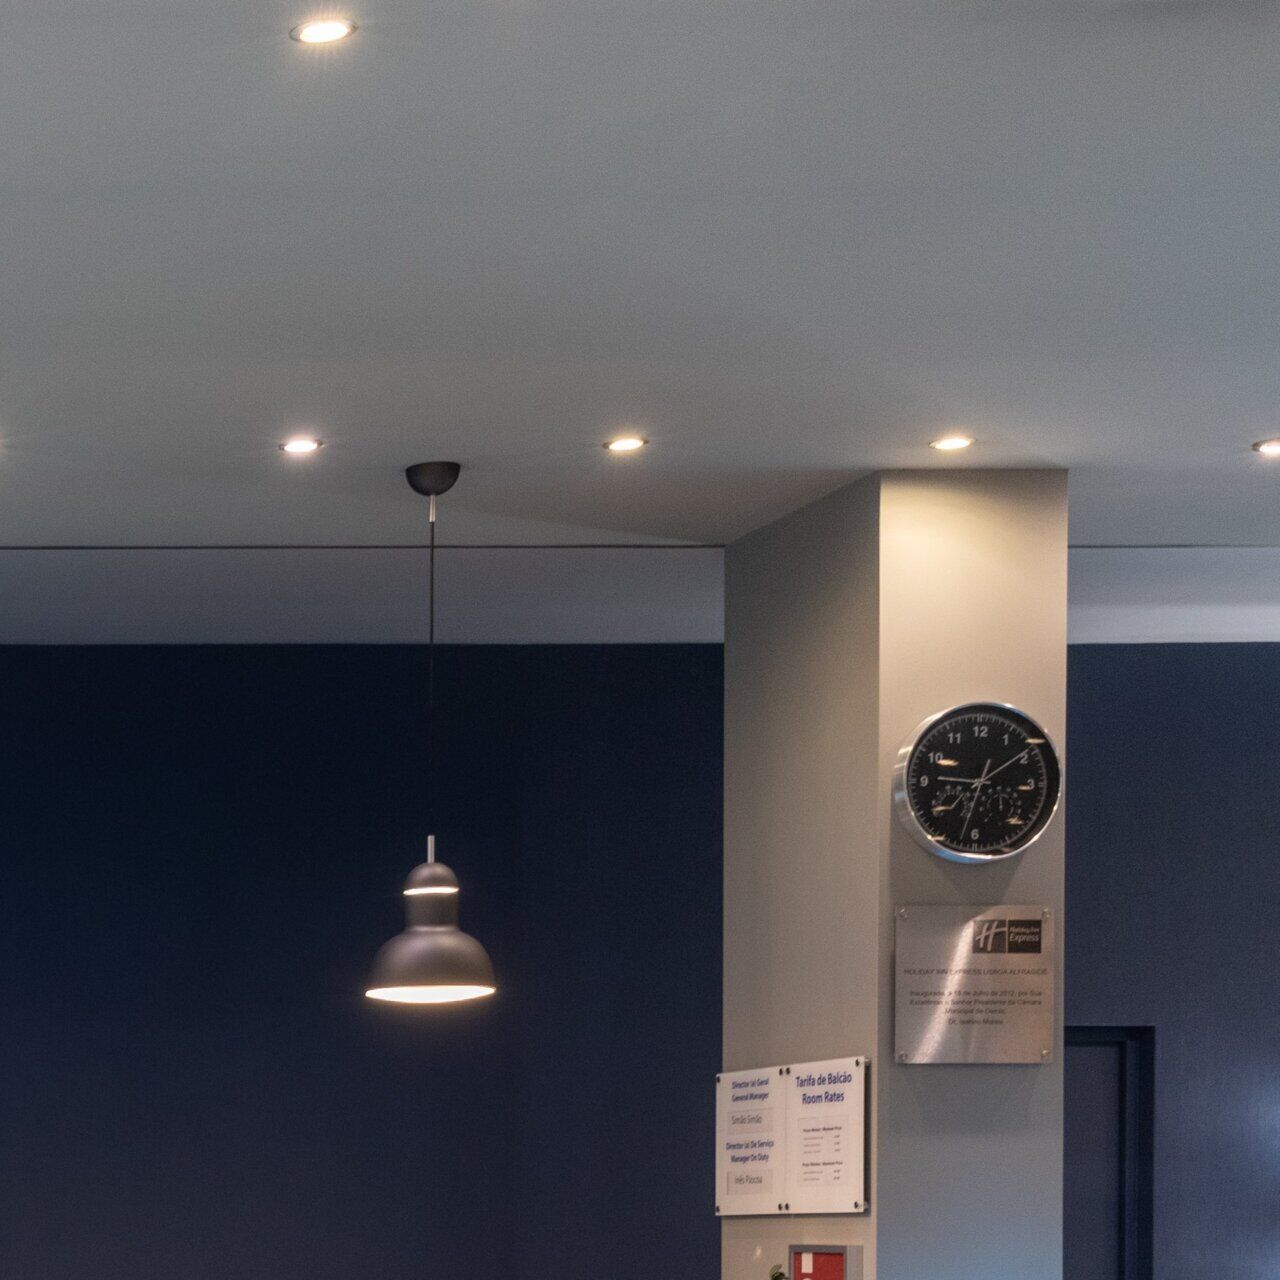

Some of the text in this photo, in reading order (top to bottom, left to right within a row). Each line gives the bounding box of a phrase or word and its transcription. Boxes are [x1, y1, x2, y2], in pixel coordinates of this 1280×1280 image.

[972, 726, 989, 737] 12
[947, 732, 961, 744] 11
[1002, 734, 1009, 745] 1
[927, 752, 944, 764] 10
[1019, 753, 1029, 764] 2
[920, 775, 929, 787] 9
[1027, 779, 1035, 790] 3
[970, 828, 979, 840] 6
[1009, 933, 1040, 943] Express
[796, 1071, 852, 1087] Tarifa de Balcão
[802, 1091, 845, 1105] Room Rates
